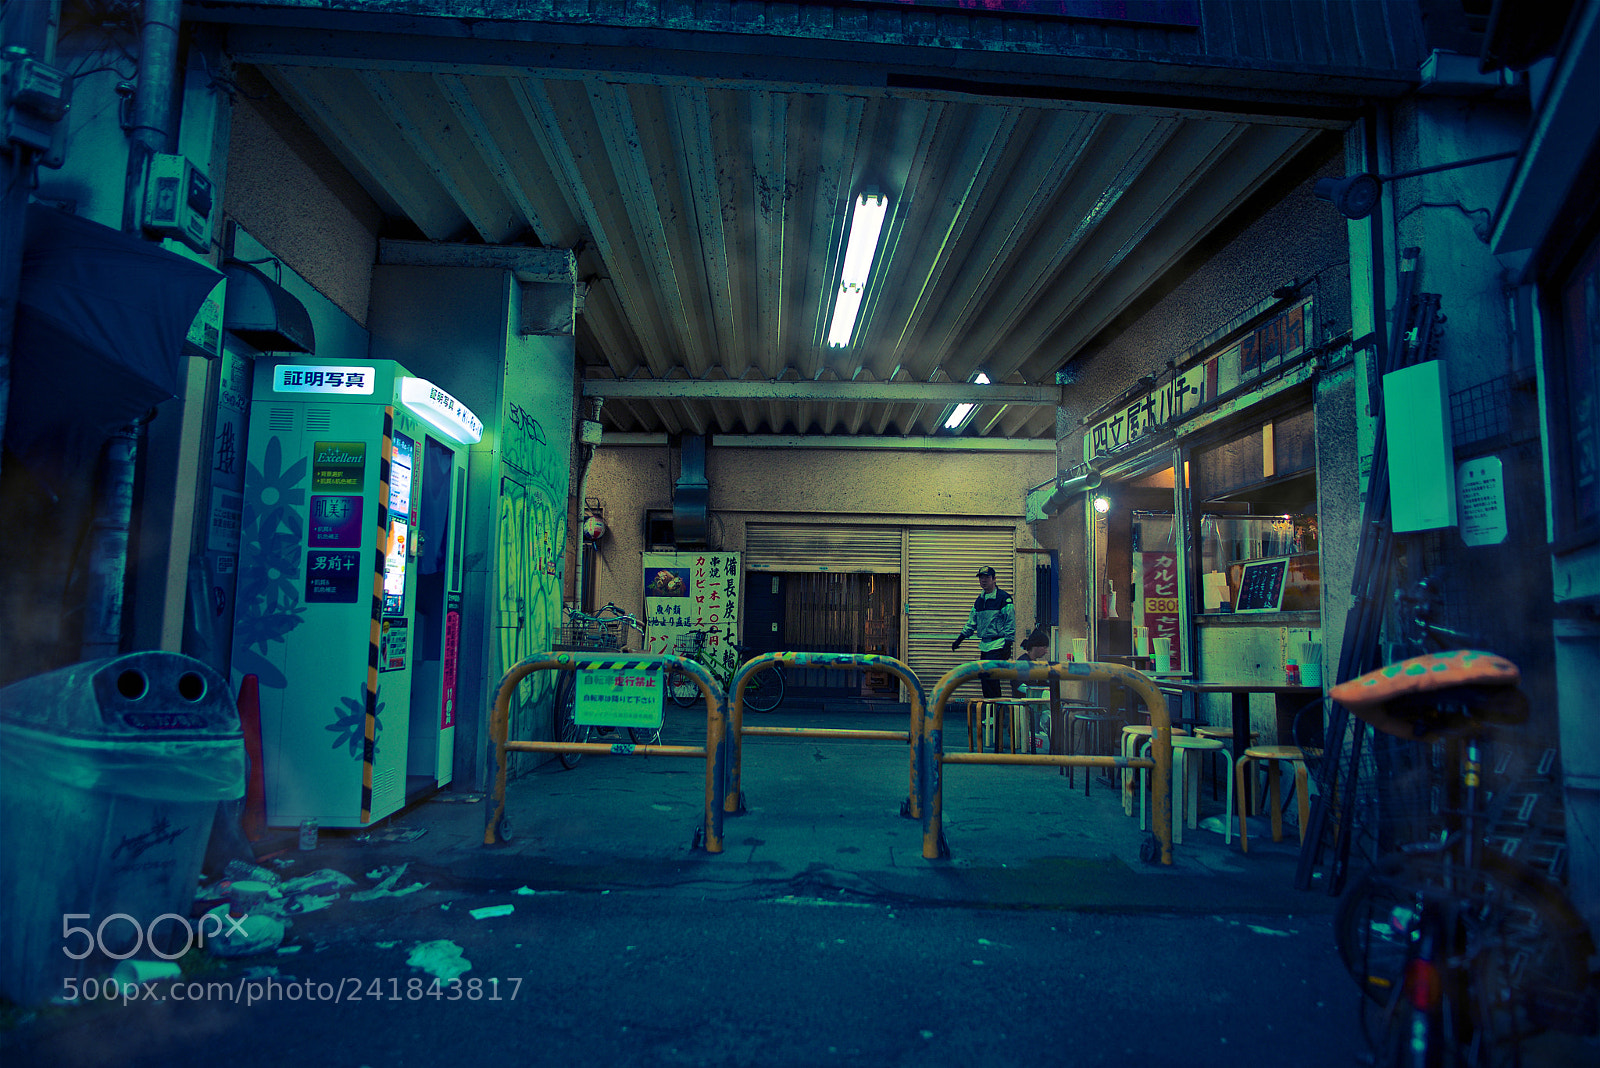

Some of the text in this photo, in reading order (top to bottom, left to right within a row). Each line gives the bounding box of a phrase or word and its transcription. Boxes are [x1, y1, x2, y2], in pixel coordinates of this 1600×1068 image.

[283, 370, 365, 388] 証明写真
[430, 387, 455, 411] 証明写真
[317, 452, 363, 463] Excellent
[1154, 555, 1175, 596] カルビ
[655, 604, 681, 615] 魚介類
[1147, 599, 1179, 612] 380
[584, 674, 656, 687] 自転車走行禁止
